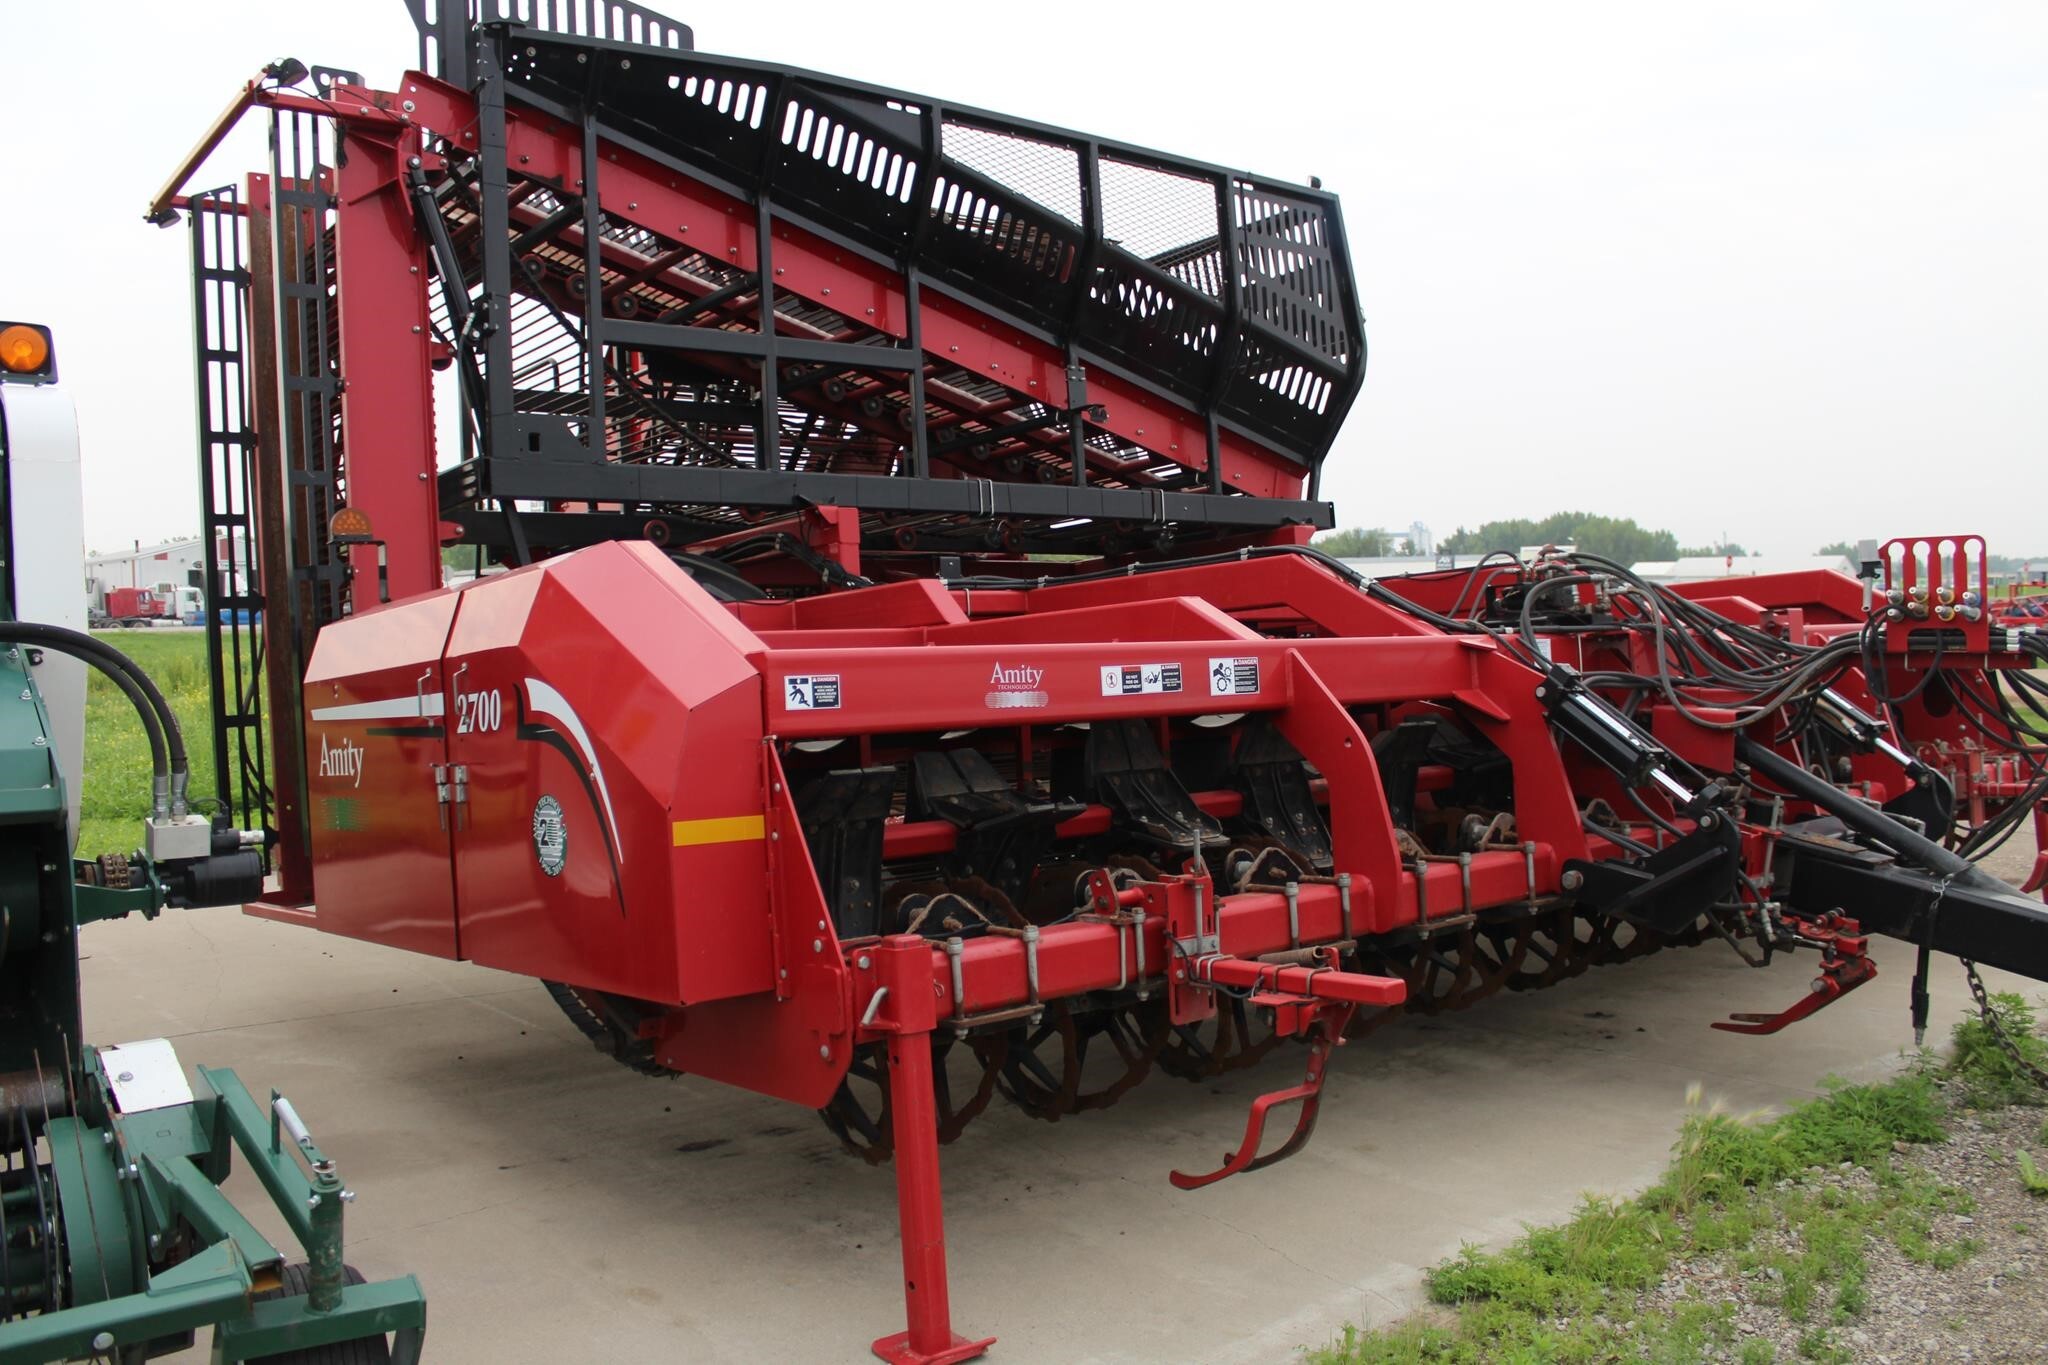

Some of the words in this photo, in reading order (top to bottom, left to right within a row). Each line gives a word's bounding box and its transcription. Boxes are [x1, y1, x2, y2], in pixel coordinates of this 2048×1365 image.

[990, 661, 1043, 689] Amity
[456, 689, 501, 734] 2700
[319, 732, 364, 788] Amity
